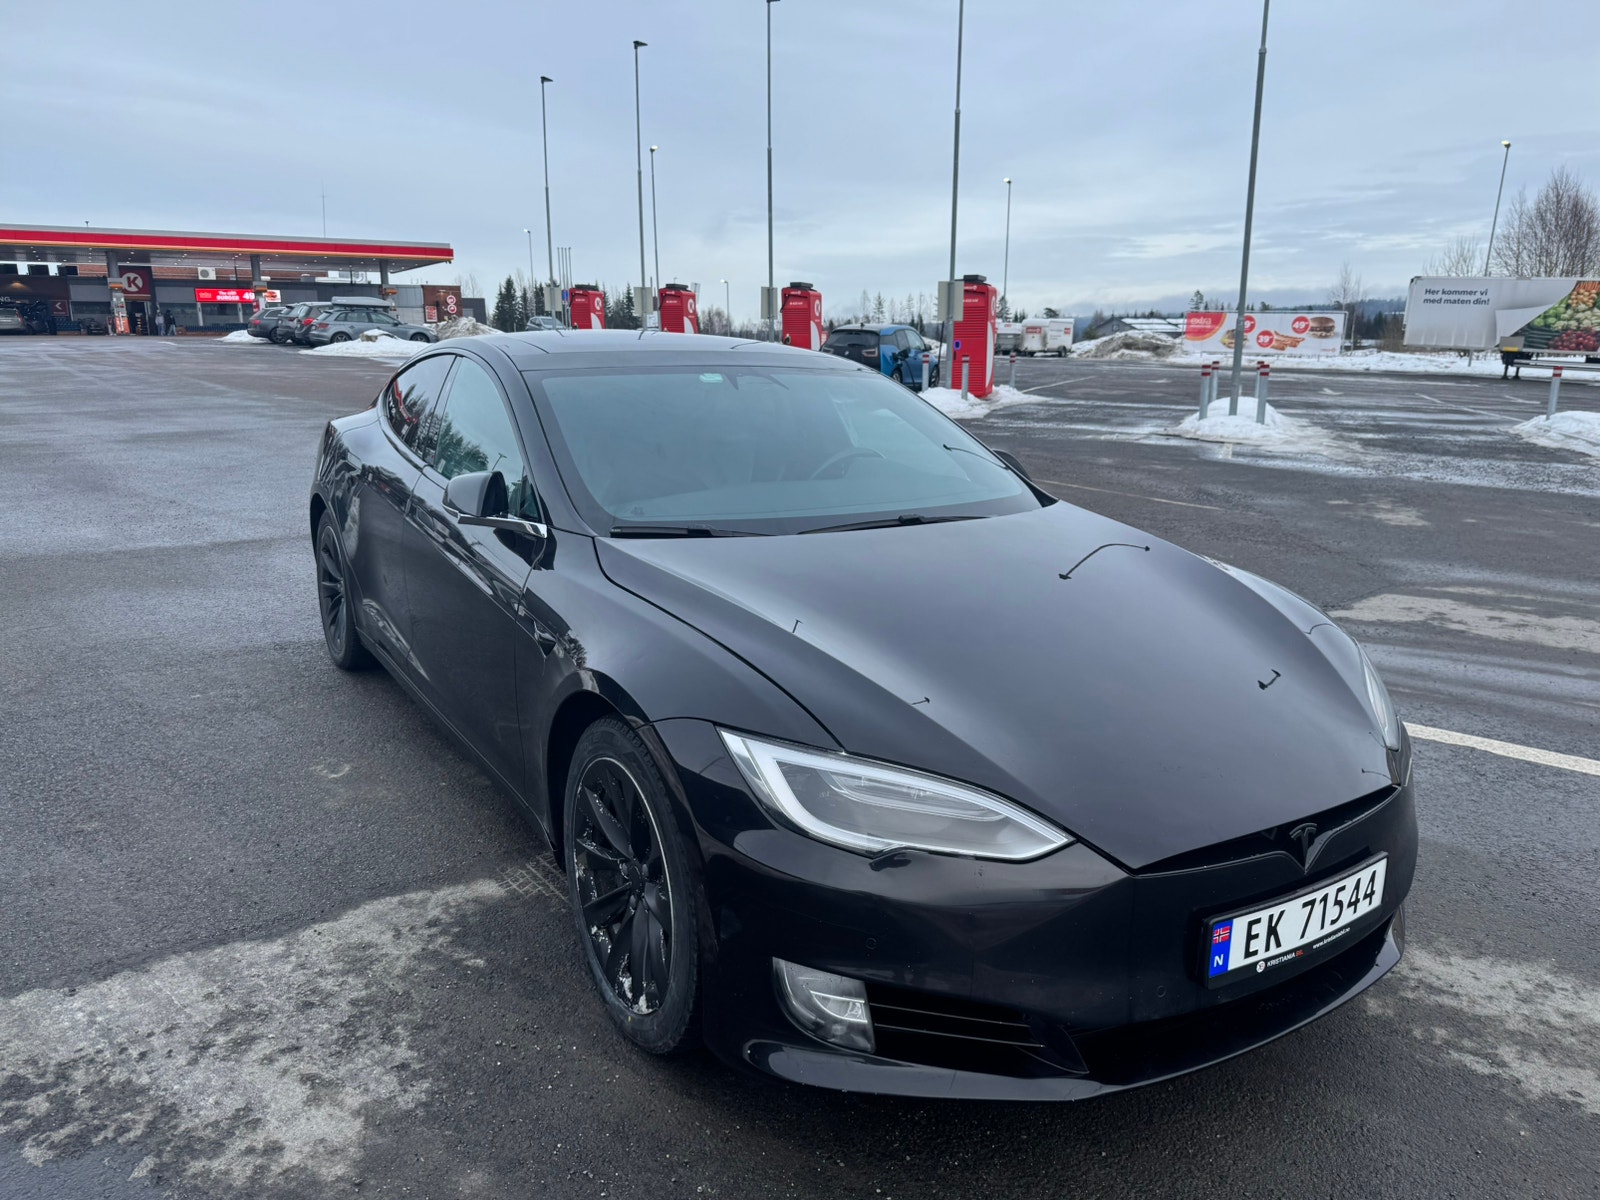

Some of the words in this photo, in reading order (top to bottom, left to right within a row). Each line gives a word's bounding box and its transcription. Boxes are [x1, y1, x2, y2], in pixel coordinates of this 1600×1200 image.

[125, 275, 141, 291] K
[1424, 288, 1440, 296] Her
[1441, 288, 1478, 296] kommer
[1479, 288, 1489, 296] vi
[1423, 297, 1442, 305] med
[1473, 298, 1490, 306] din!
[1244, 908, 1286, 960] EK
[1299, 869, 1377, 940] 71544
[1213, 953, 1224, 968] N
[1266, 952, 1296, 968] KRISTIANIA
